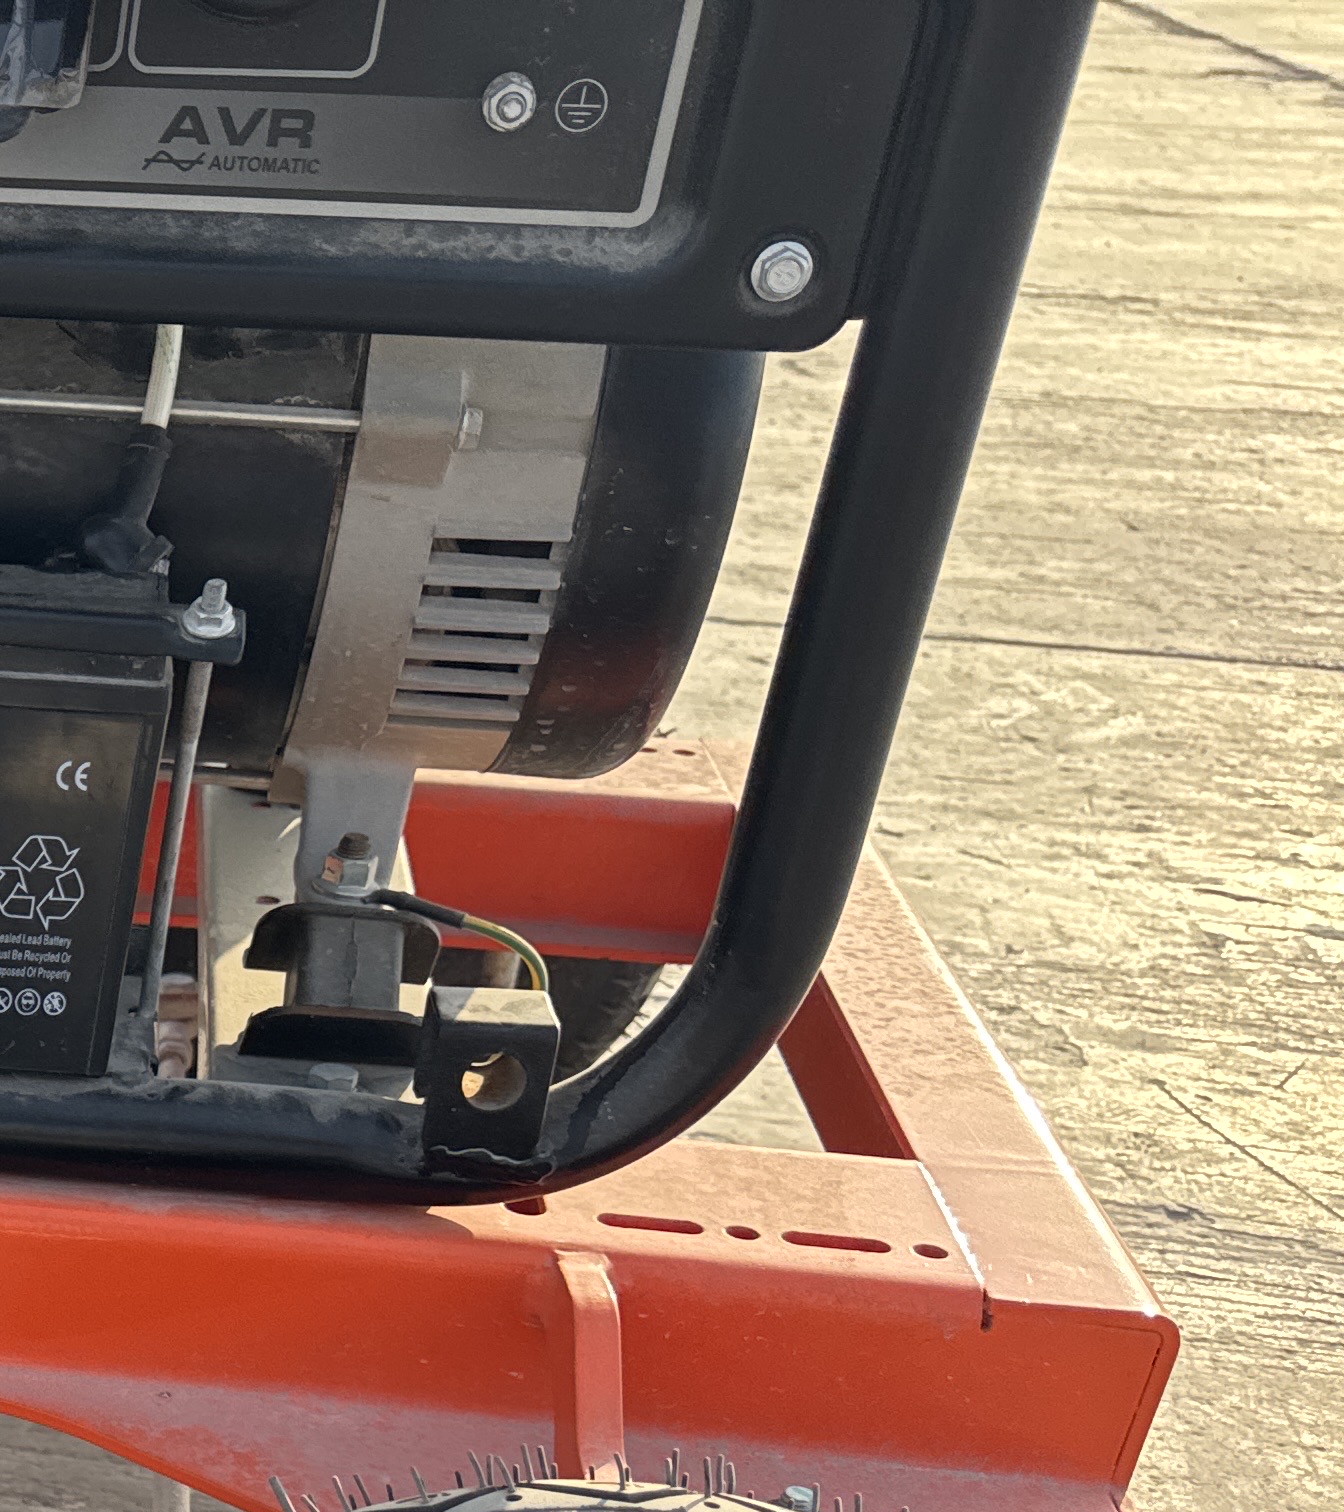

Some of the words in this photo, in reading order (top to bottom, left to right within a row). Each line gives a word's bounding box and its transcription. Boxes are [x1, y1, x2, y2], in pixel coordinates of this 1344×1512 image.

[158, 105, 315, 149] AVR
[208, 155, 320, 174] AUTOMATIC
[22, 933, 42, 946] Lead
[43, 934, 72, 949] Battery
[23, 950, 60, 964] Recycled
